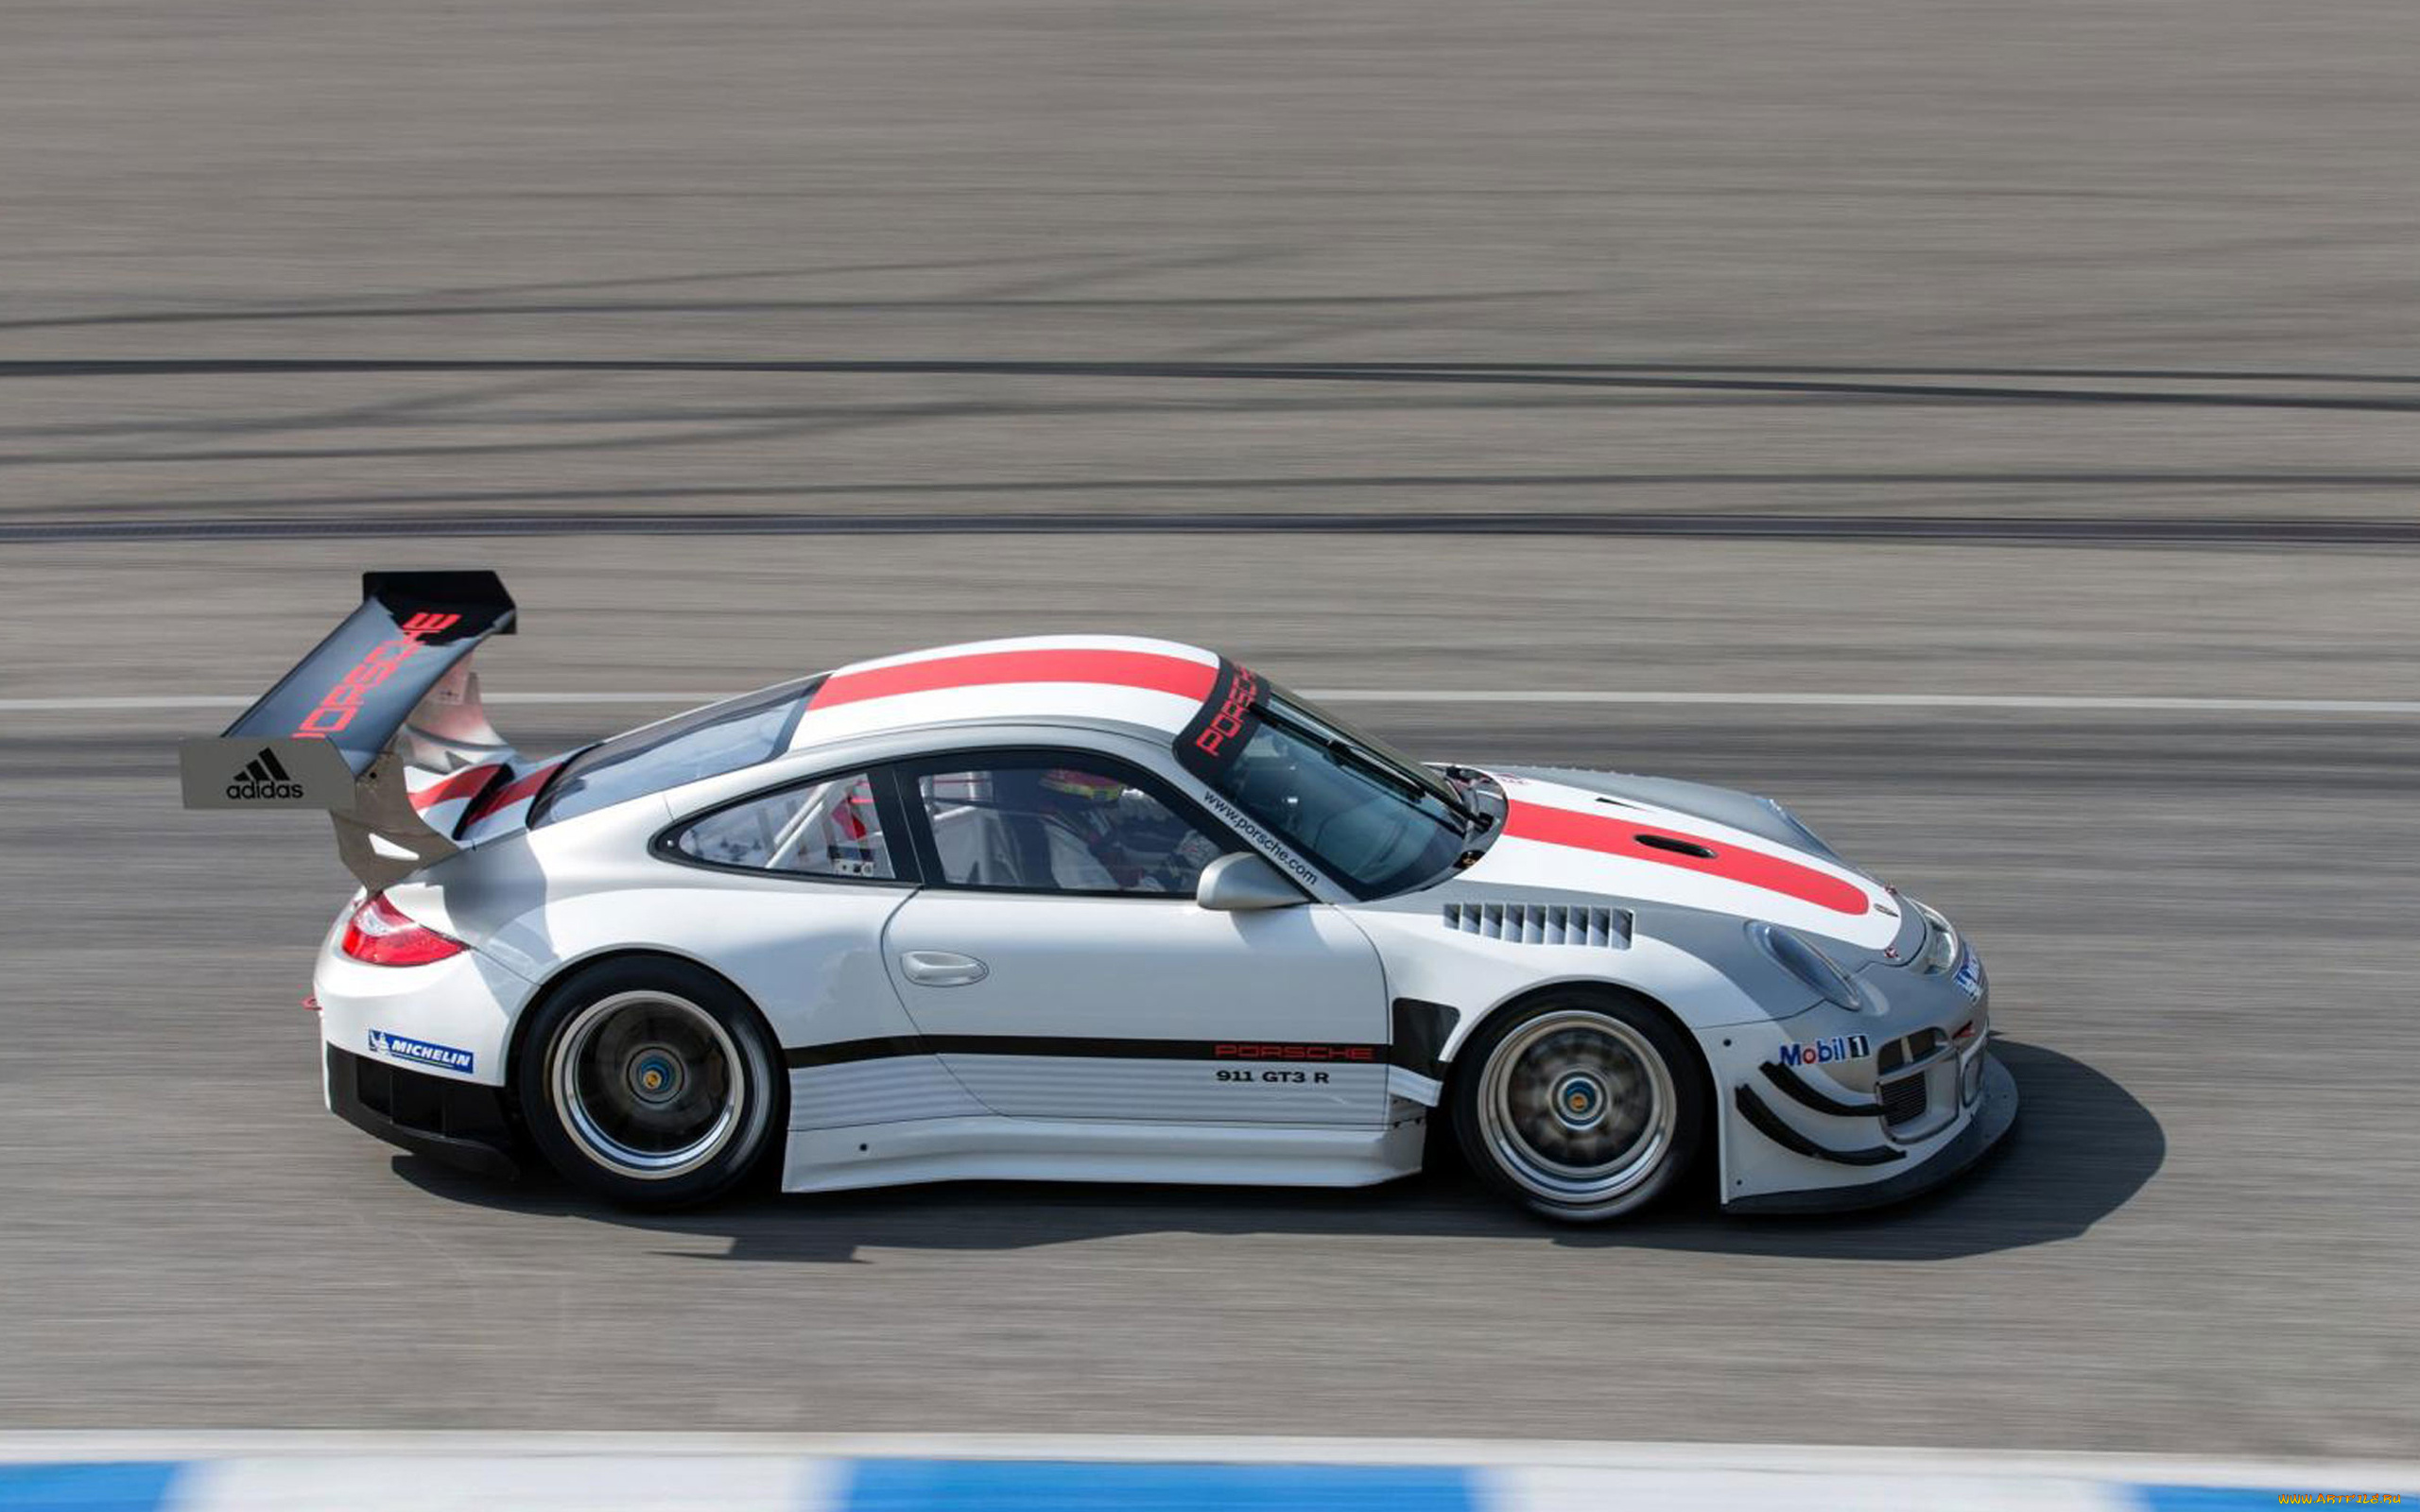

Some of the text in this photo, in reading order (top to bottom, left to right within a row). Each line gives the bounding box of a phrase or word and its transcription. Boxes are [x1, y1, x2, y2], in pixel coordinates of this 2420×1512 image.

[290, 612, 461, 740] ORSCHE
[226, 782, 304, 799] adidas
[1203, 790, 1319, 885] www.porsche.com
[391, 1040, 472, 1067] MICHELIN
[1215, 1044, 1374, 1060] PORSCHE
[1779, 1036, 1868, 1066] Mobil 1
[1217, 1070, 1330, 1084] 911 GT3 R
